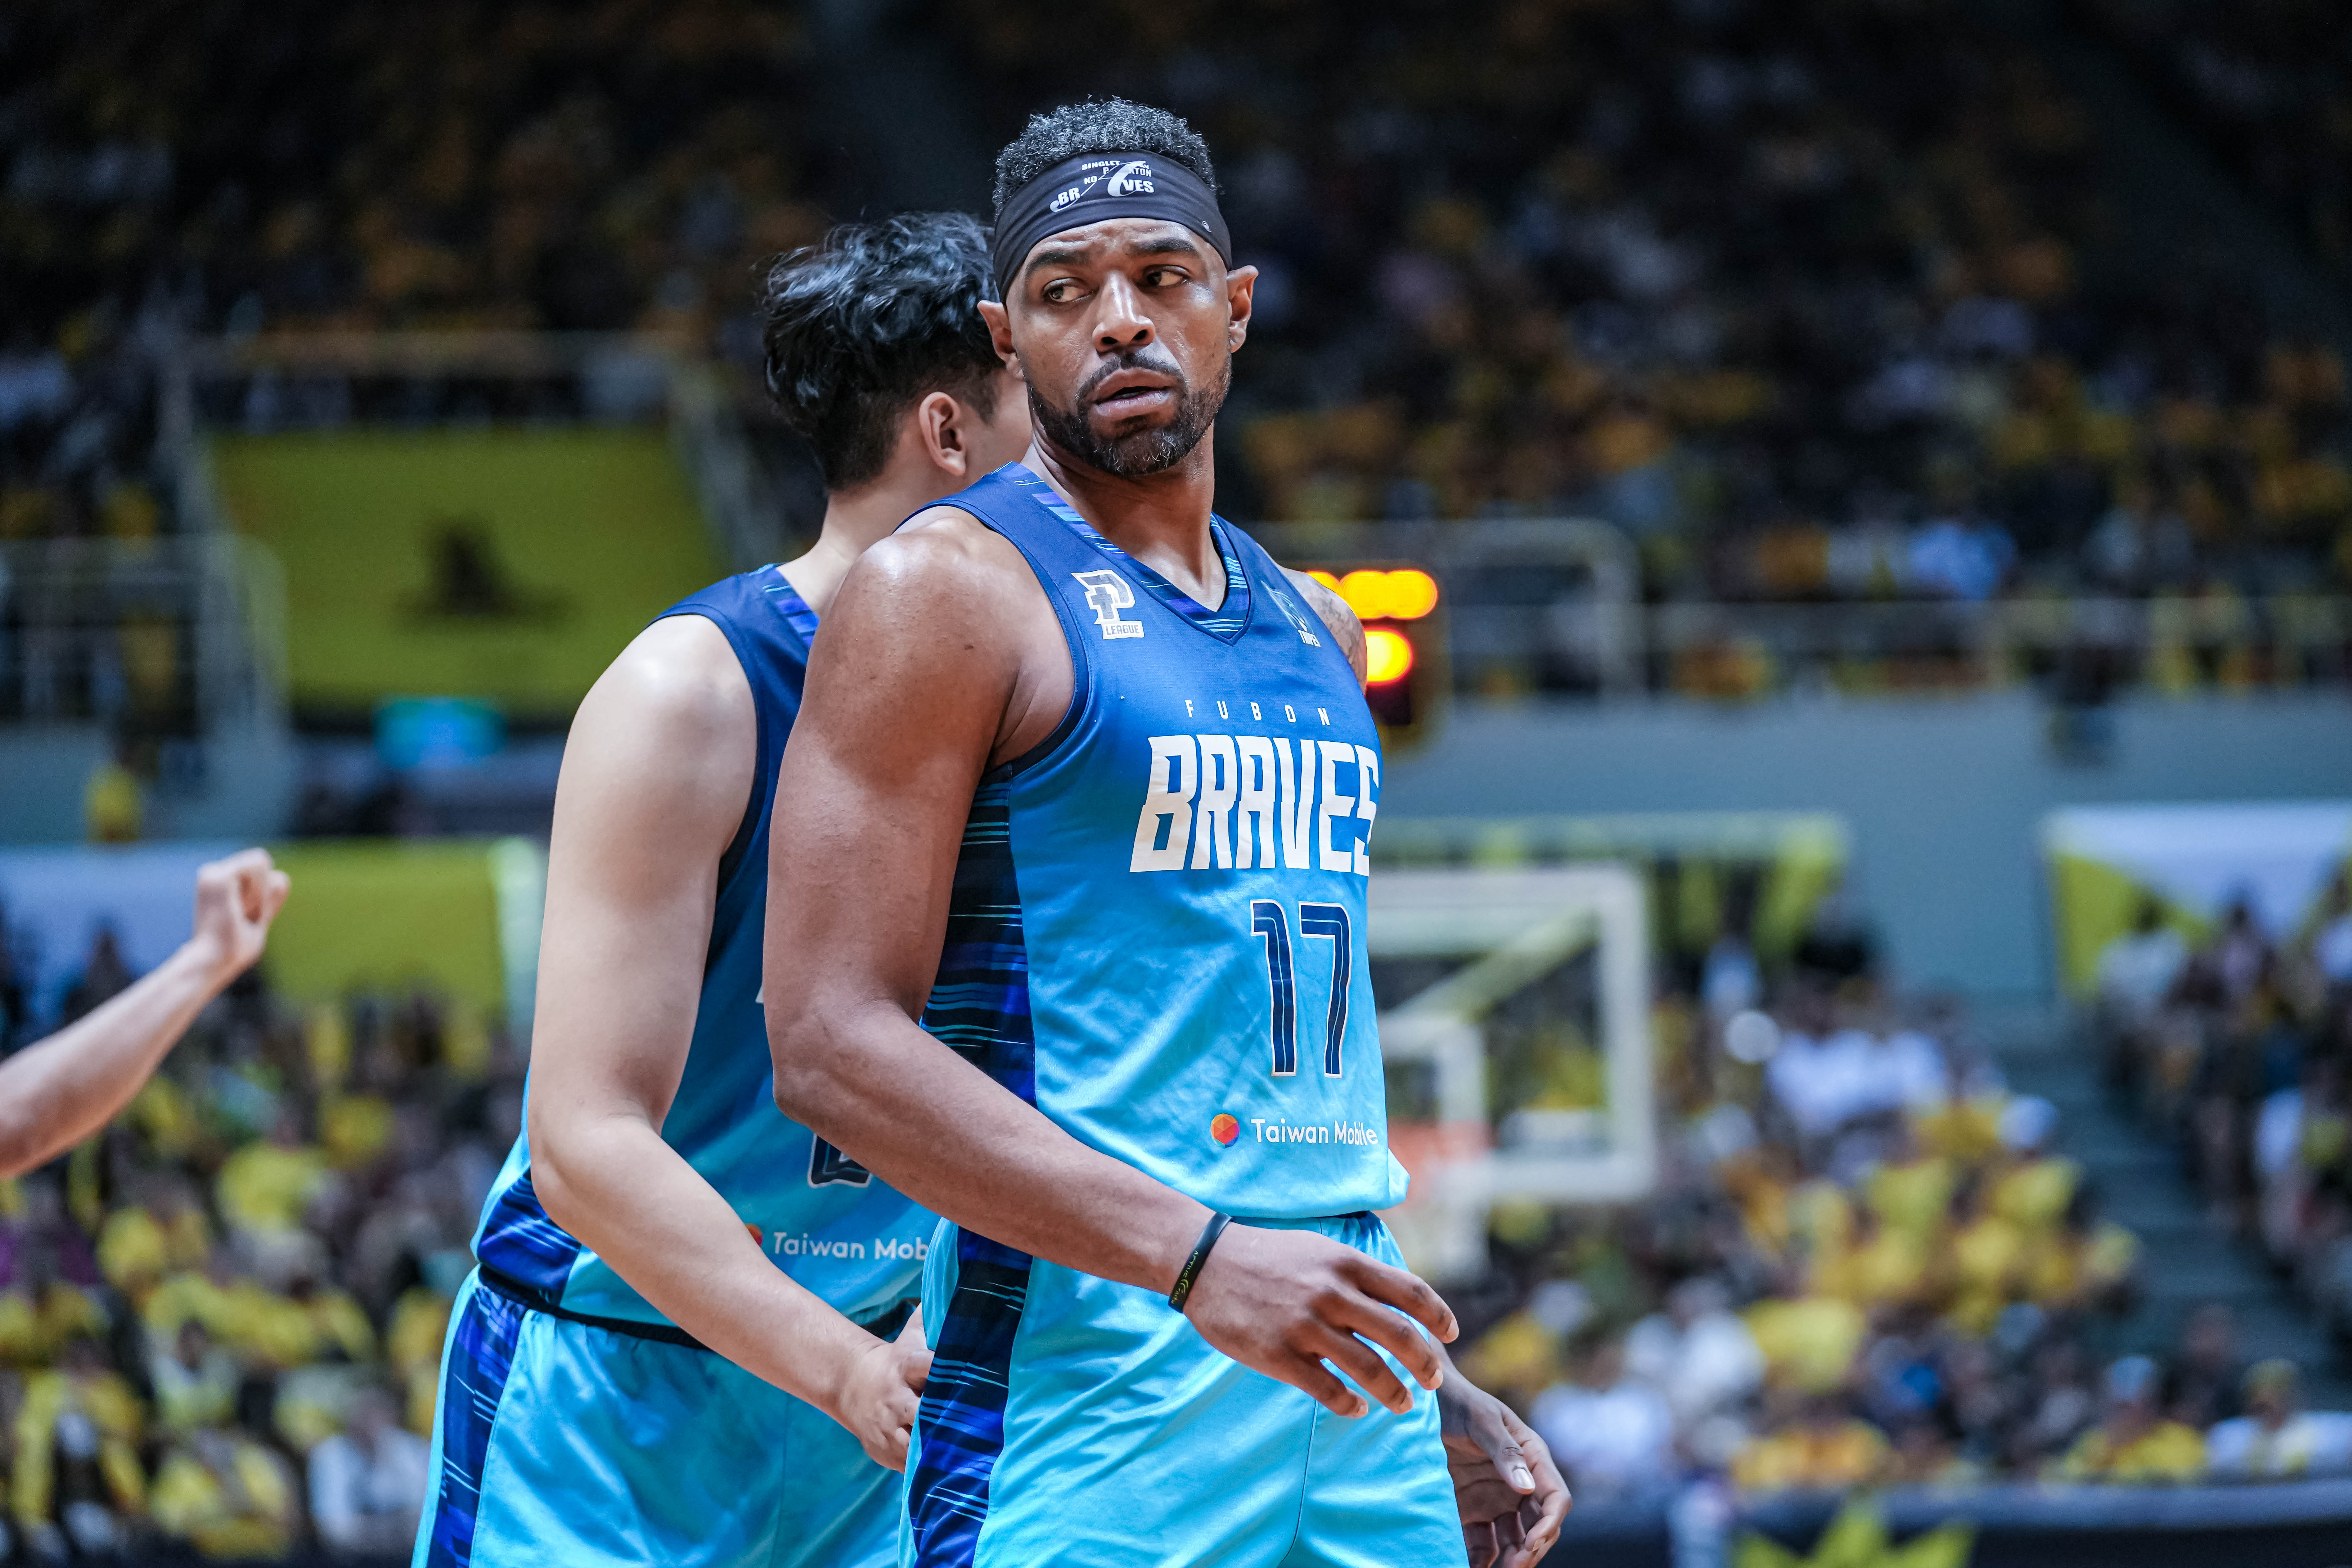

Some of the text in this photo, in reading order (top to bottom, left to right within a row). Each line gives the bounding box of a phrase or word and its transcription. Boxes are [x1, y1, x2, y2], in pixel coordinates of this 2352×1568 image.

[1106, 625, 1140, 635] LEAGUE
[1184, 700, 1331, 725] FUBON
[1129, 734, 1379, 877] BRAVES
[1250, 899, 1352, 1078] 17
[1251, 1118, 1379, 1146] Taiwan Mobile
[773, 1231, 865, 1259] Taiwan
